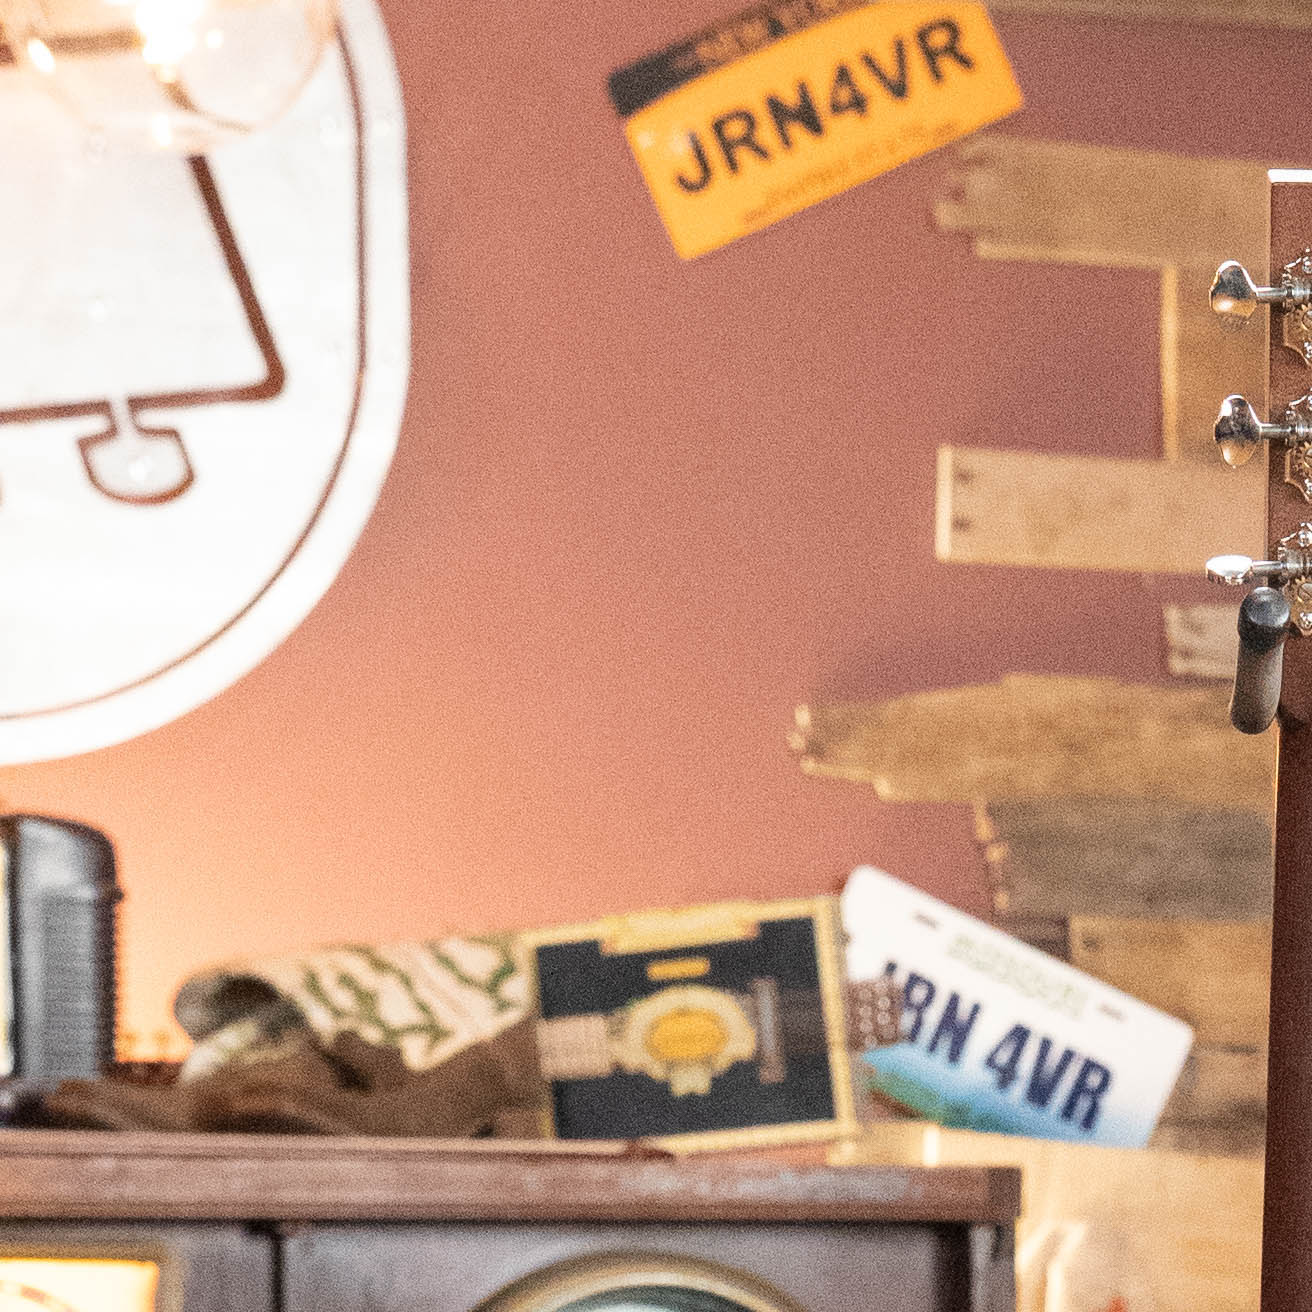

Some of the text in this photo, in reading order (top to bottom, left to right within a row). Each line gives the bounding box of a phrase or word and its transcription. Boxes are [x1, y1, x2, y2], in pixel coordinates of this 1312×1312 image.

[675, 17, 975, 193] JRN4VR
[884, 957, 982, 1066] RN
[984, 1022, 1115, 1133] 4VR
